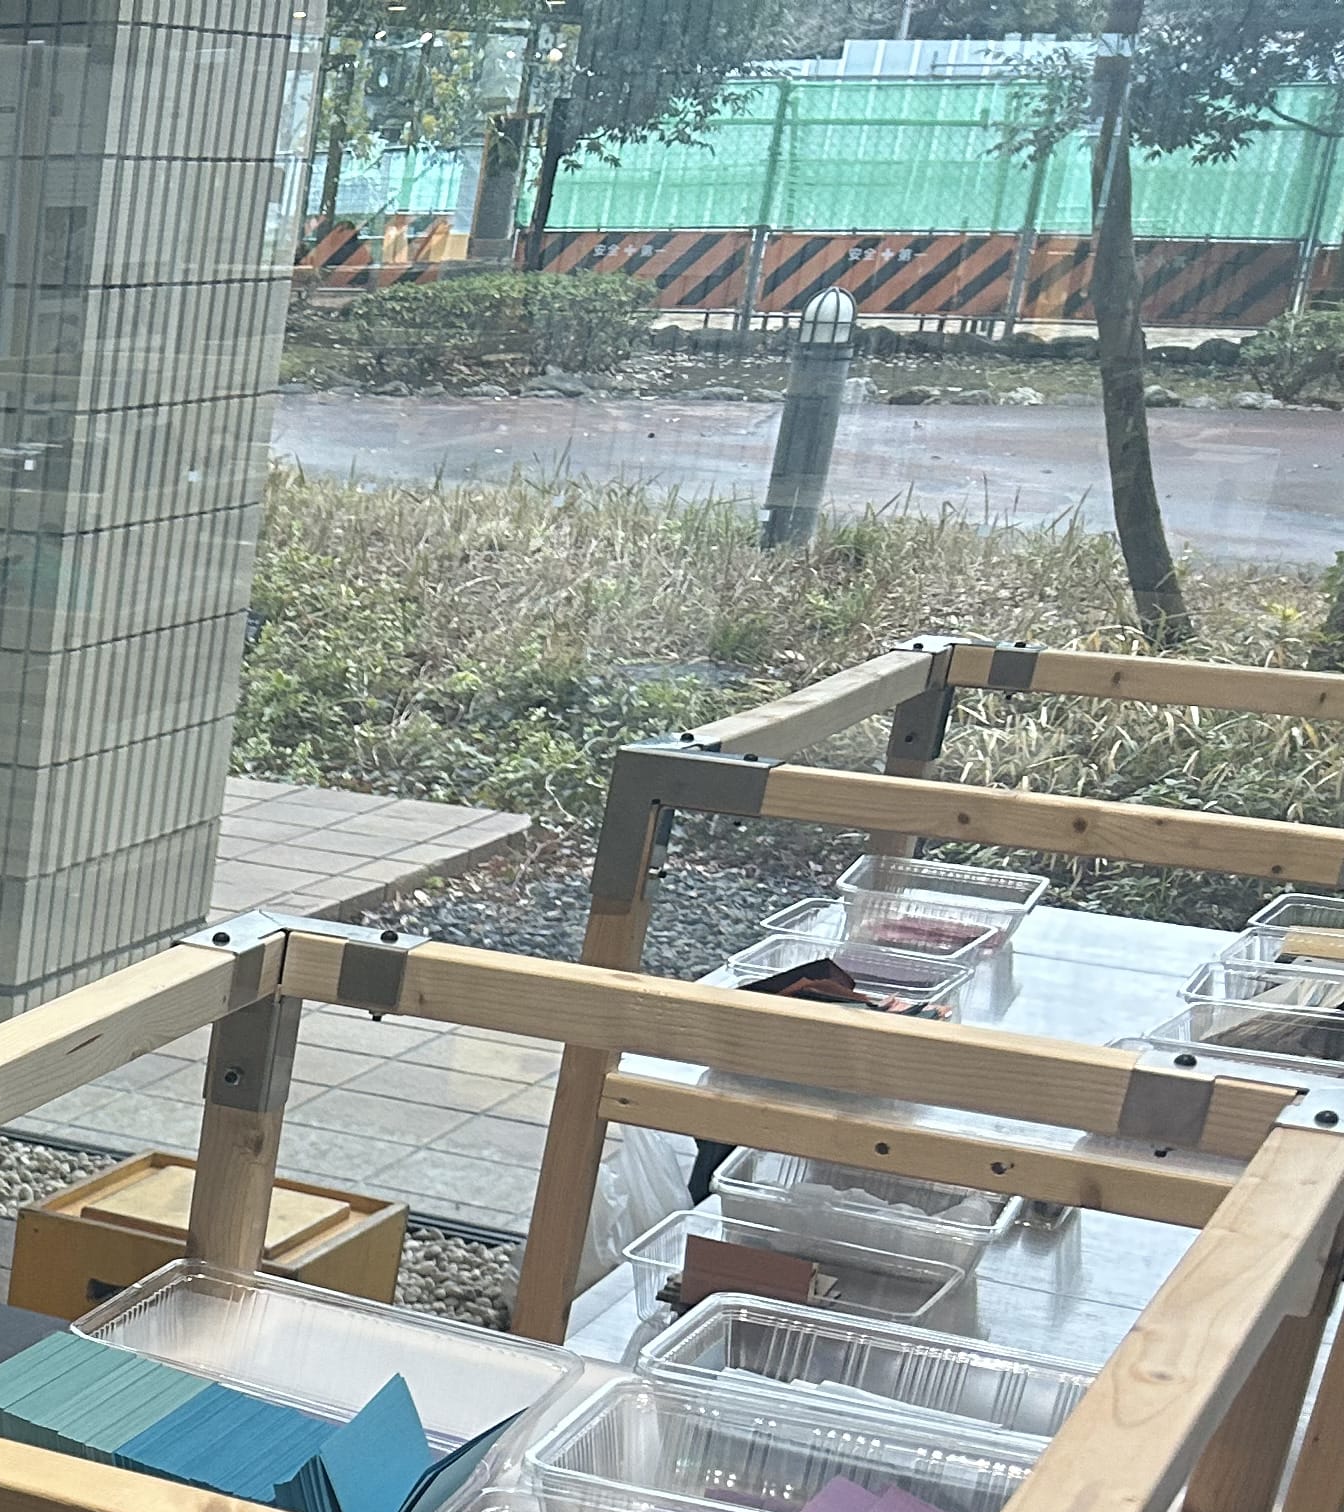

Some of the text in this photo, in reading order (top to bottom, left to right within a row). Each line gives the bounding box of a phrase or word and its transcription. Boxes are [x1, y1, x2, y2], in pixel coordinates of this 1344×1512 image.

[593, 244, 620, 257] 安全
[848, 248, 928, 262] 安全 第一
